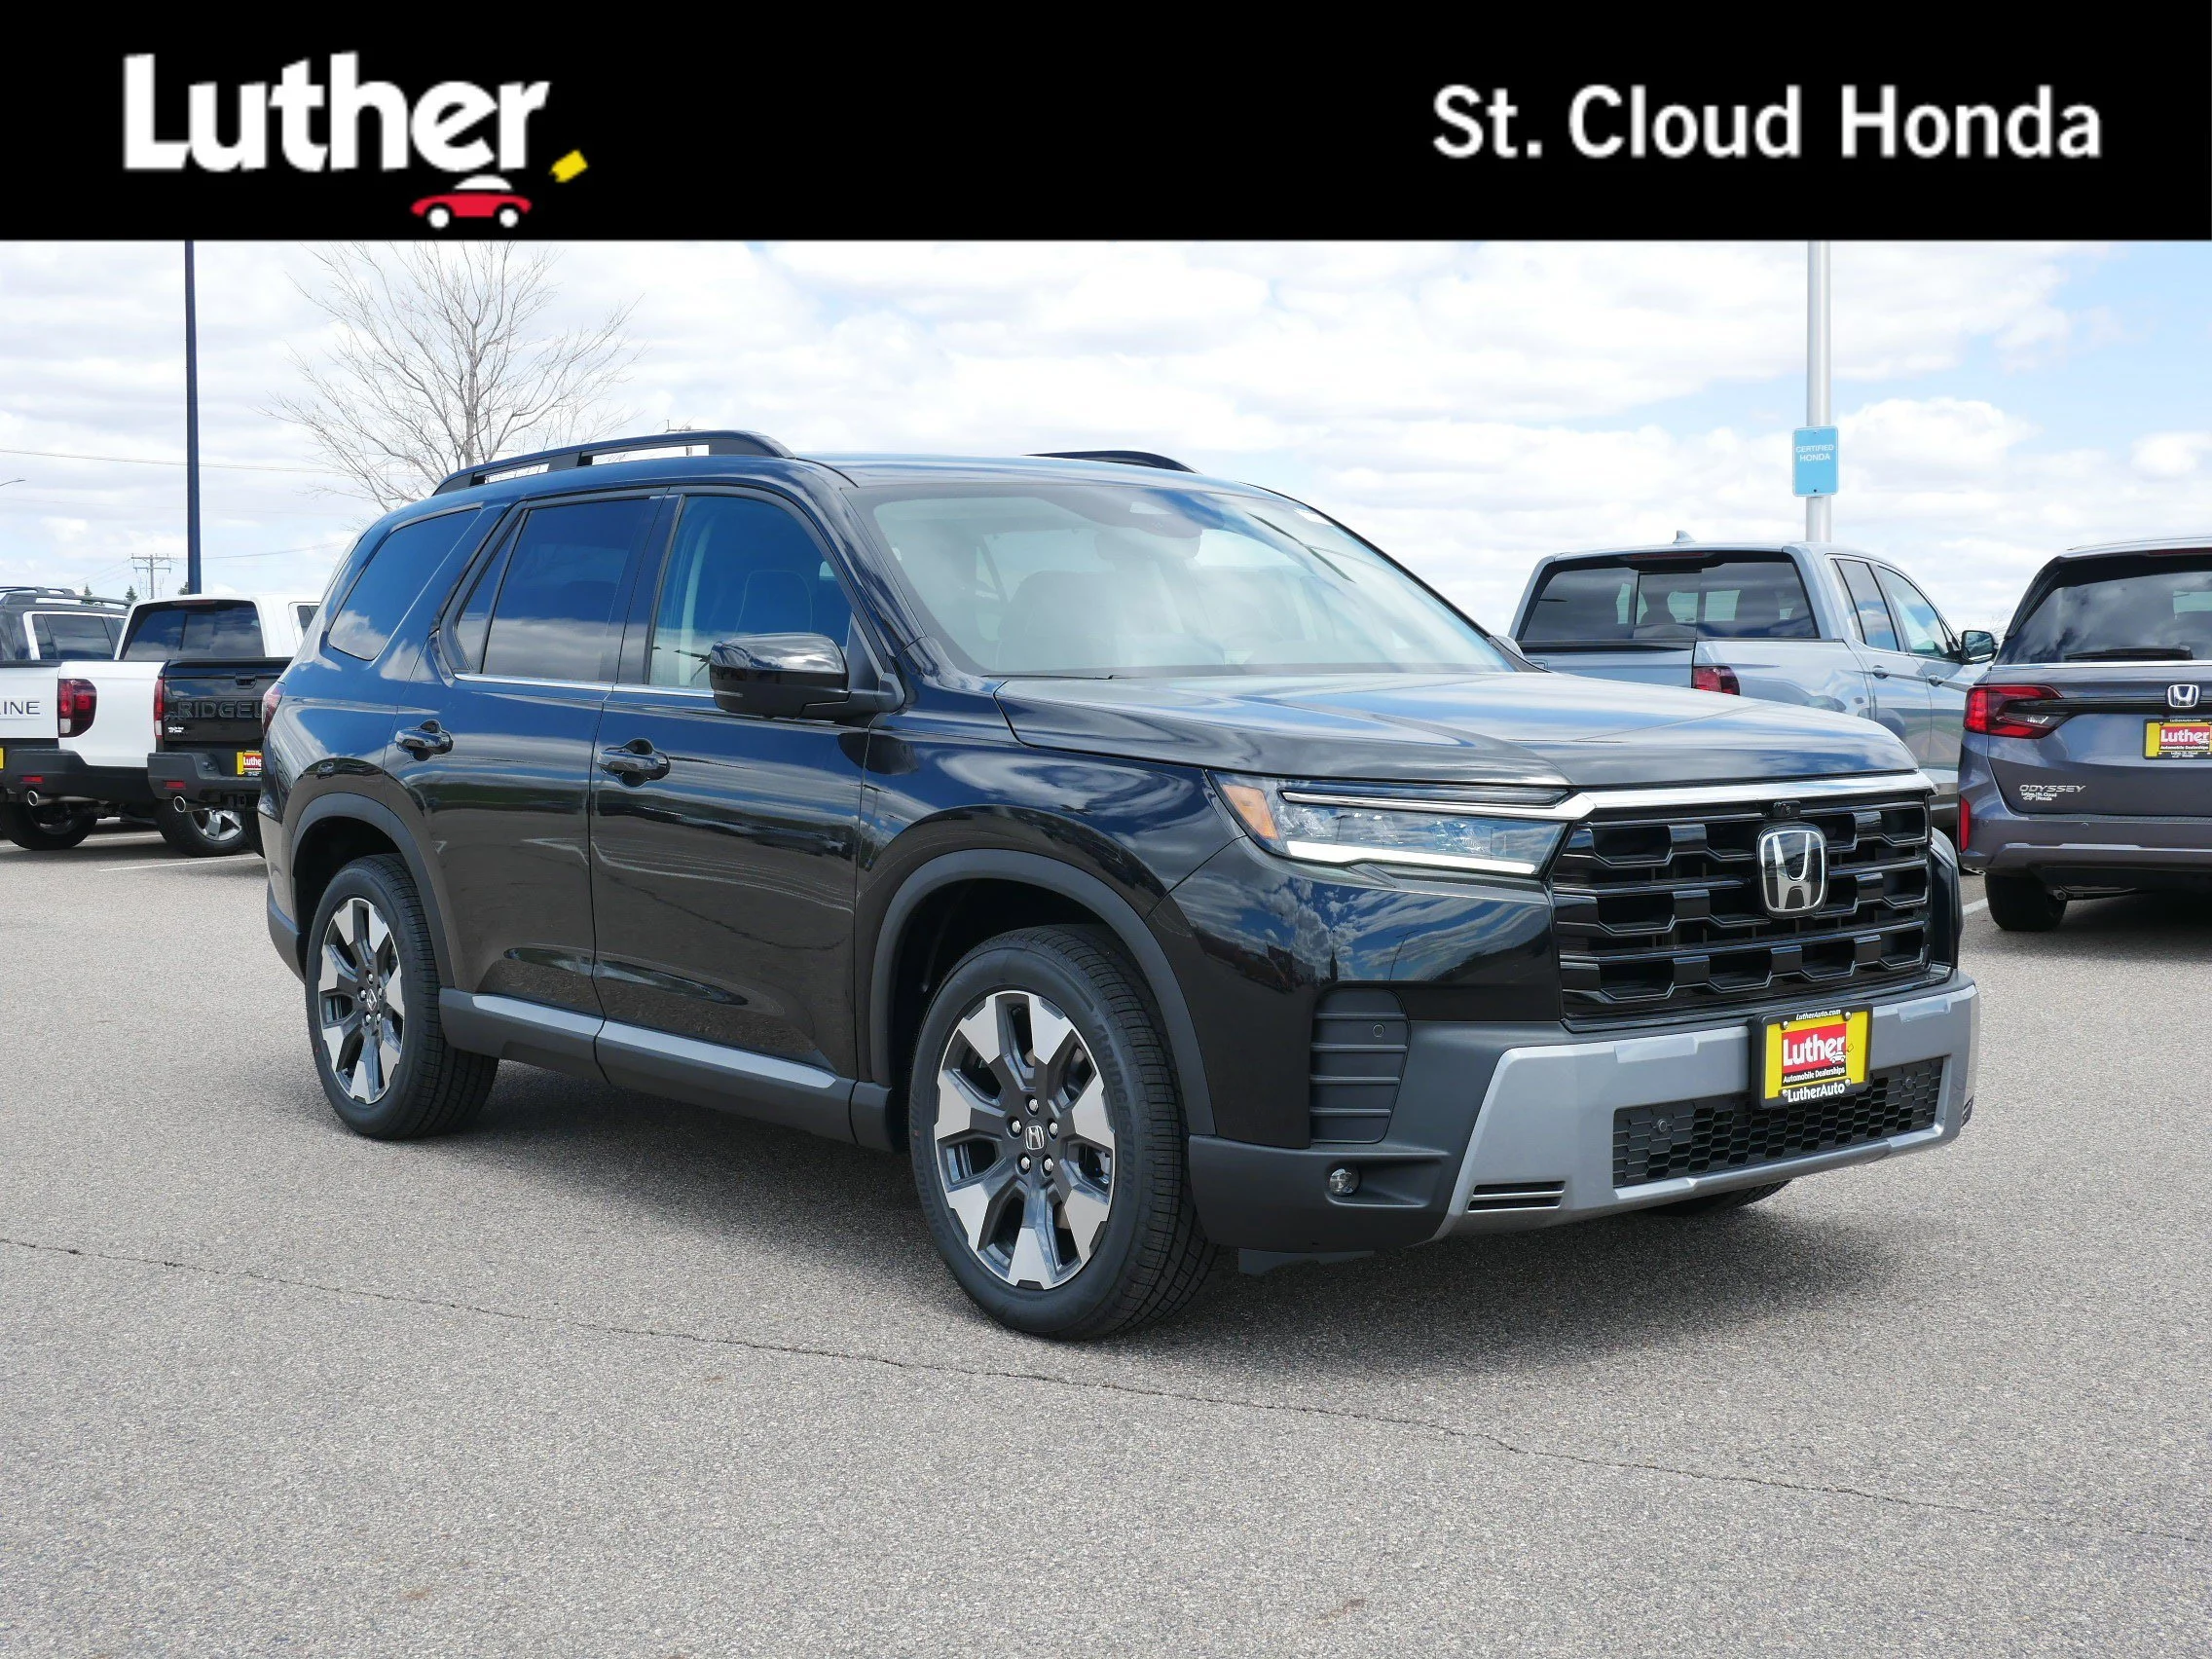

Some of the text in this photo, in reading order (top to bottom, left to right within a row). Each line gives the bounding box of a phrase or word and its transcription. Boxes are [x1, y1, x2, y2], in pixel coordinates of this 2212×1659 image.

[1795, 444, 1834, 453] CERTIFIED
[1799, 453, 1830, 461] HONDA
[0, 700, 41, 716] INE
[2160, 728, 2210, 743] Luther
[2019, 784, 2086, 793] ODYSSEY
[1795, 1010, 1841, 1021] LutherAuto.com
[1783, 1033, 1846, 1066] Luther
[1783, 1065, 1846, 1084] Automobile Dealerships
[1788, 1082, 1846, 1103] LutherAuto
